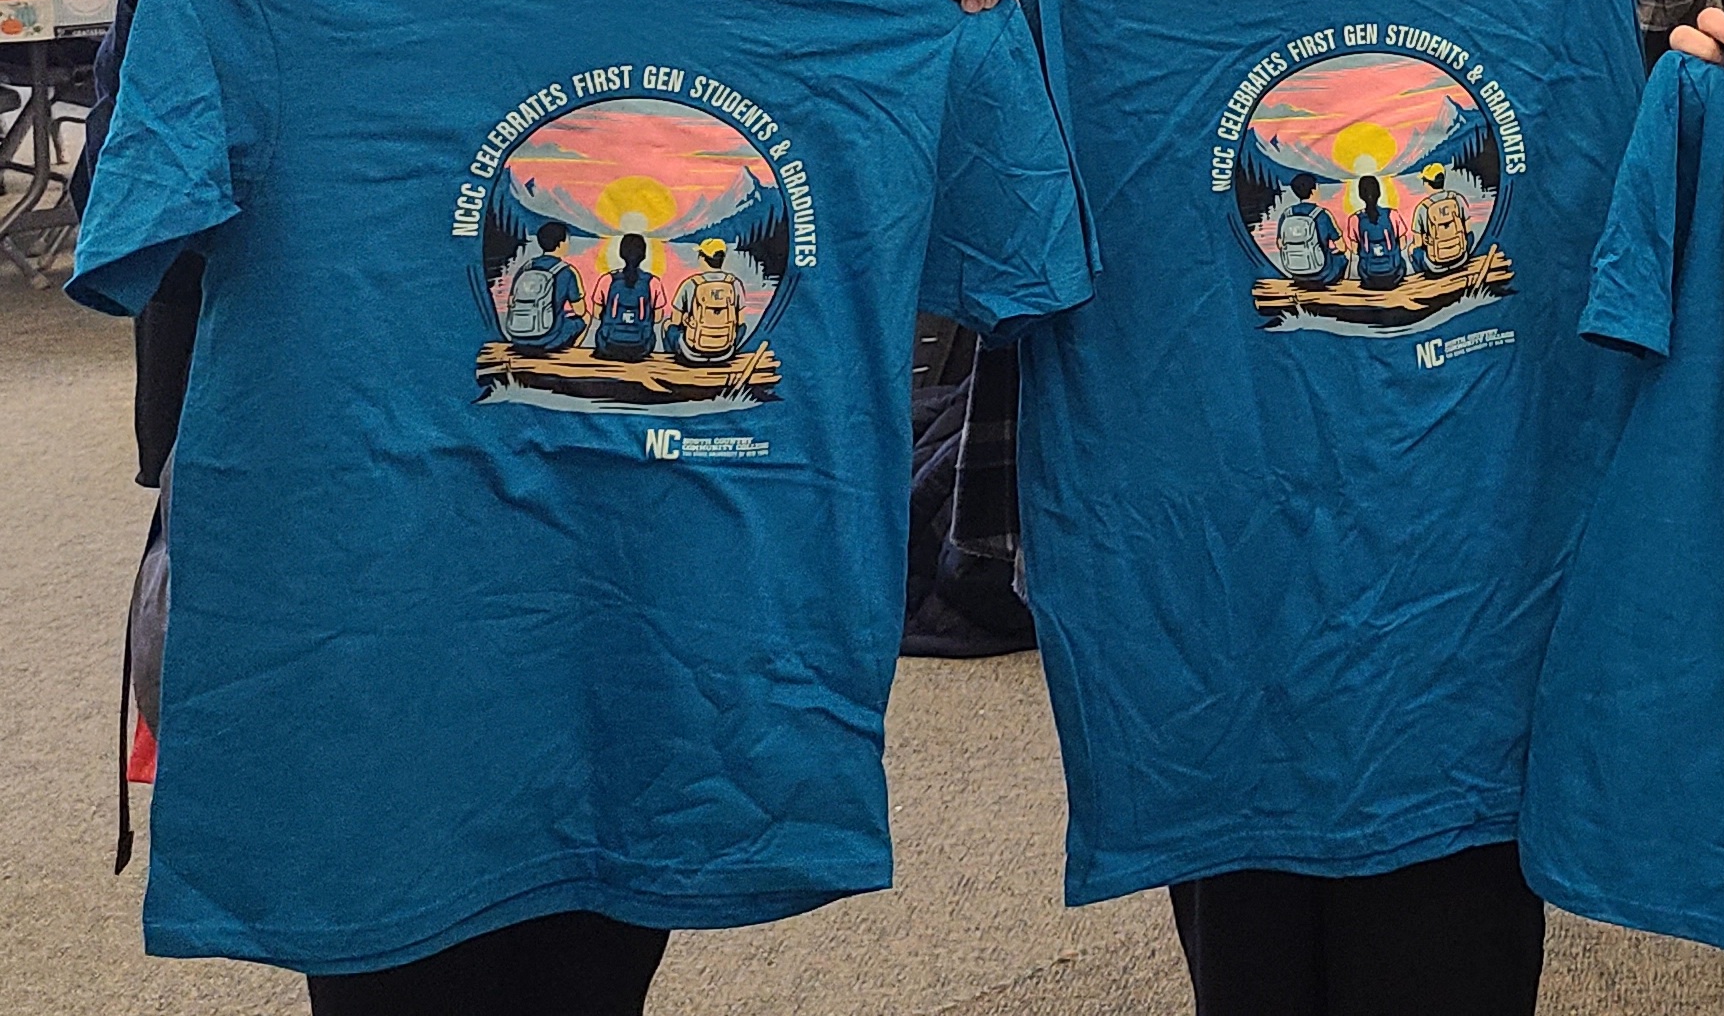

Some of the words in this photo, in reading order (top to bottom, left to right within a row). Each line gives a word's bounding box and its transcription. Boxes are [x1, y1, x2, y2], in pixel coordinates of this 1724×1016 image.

[1287, 28, 1336, 63] FIRST
[1344, 23, 1378, 45] GEN
[1386, 24, 1470, 70] STUDENTS
[572, 65, 633, 98] FIRST
[643, 65, 685, 93] GEN
[1467, 64, 1484, 84] &
[689, 75, 779, 141] STUDENTS
[1217, 51, 1288, 141] CELEBRATES
[470, 83, 568, 178] CELEBRATES
[1479, 80, 1526, 175] GRADUATES
[769, 139, 791, 161] &
[1212, 146, 1235, 192] NCCC
[452, 183, 486, 237] NCCC
[779, 160, 817, 268] GRADUATES
[1416, 338, 1445, 370] NC
[645, 428, 681, 460] NC
